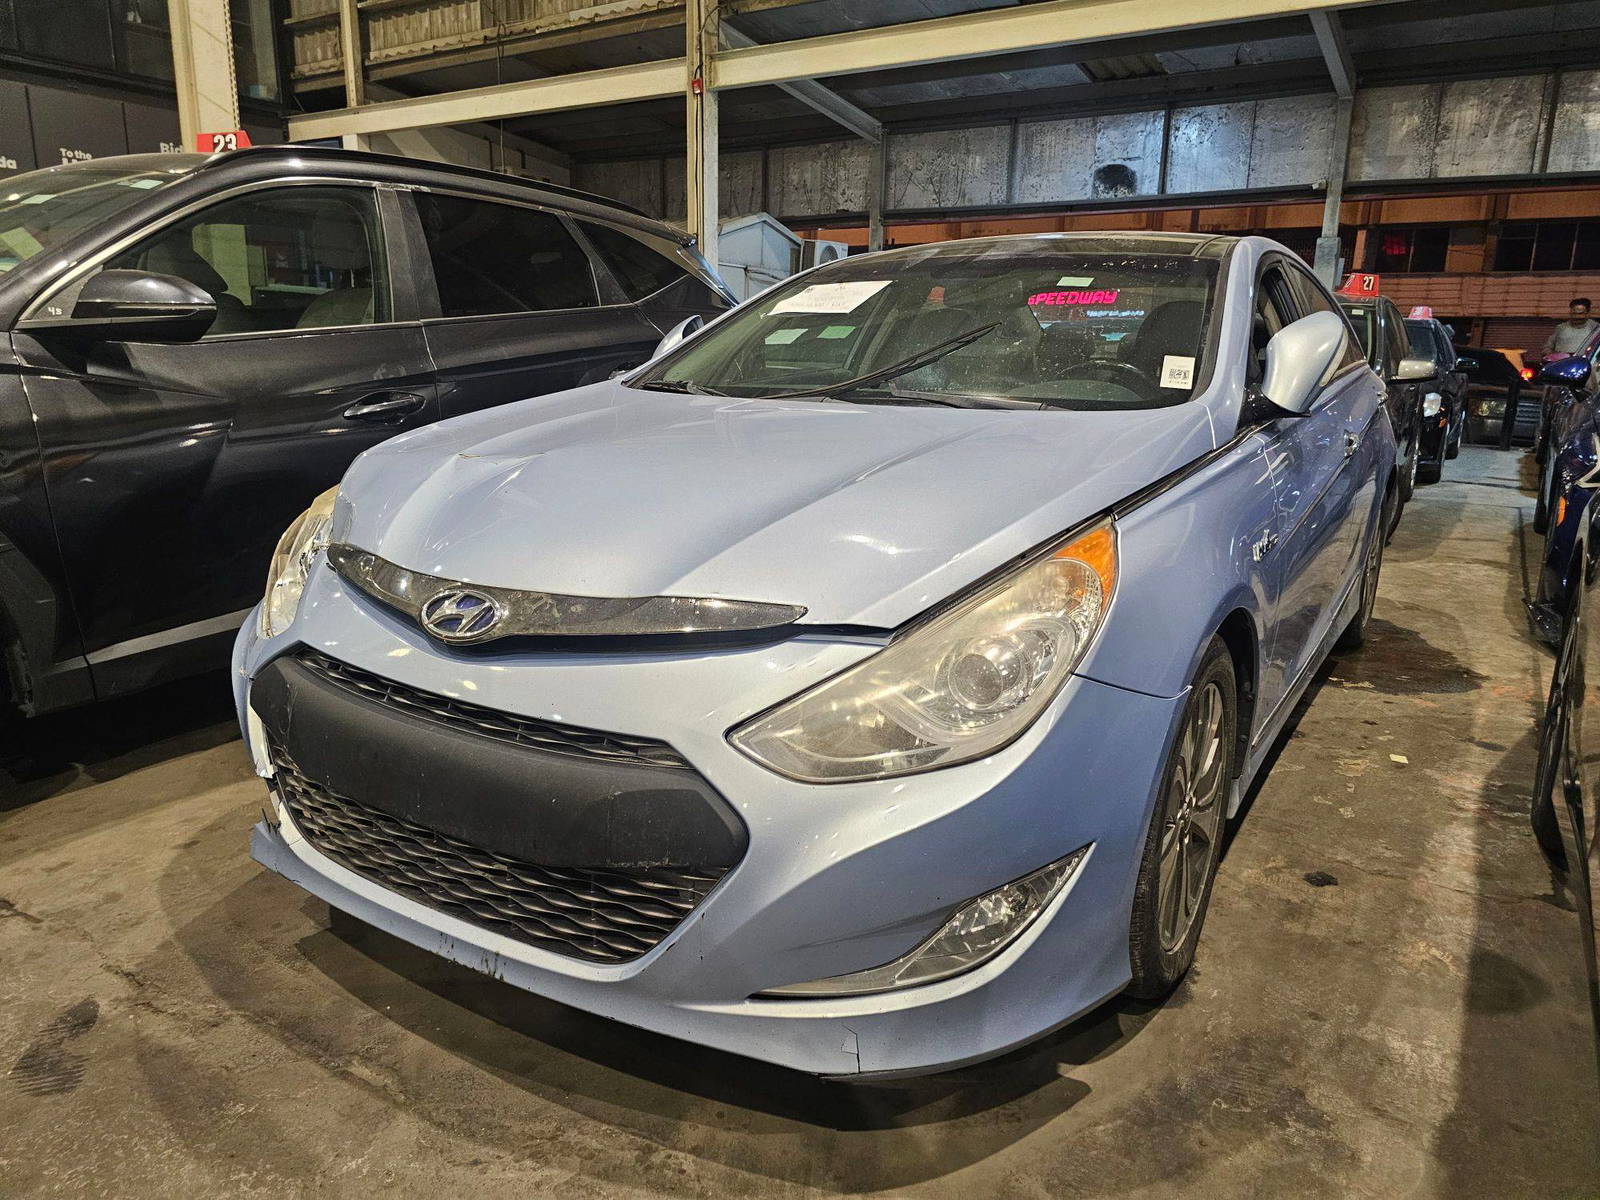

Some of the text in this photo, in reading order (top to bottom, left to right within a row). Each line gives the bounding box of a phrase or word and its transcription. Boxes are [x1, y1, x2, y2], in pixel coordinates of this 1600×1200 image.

[213, 134, 237, 153] 23
[60, 148, 92, 160] To the
[1363, 276, 1375, 291] 27
